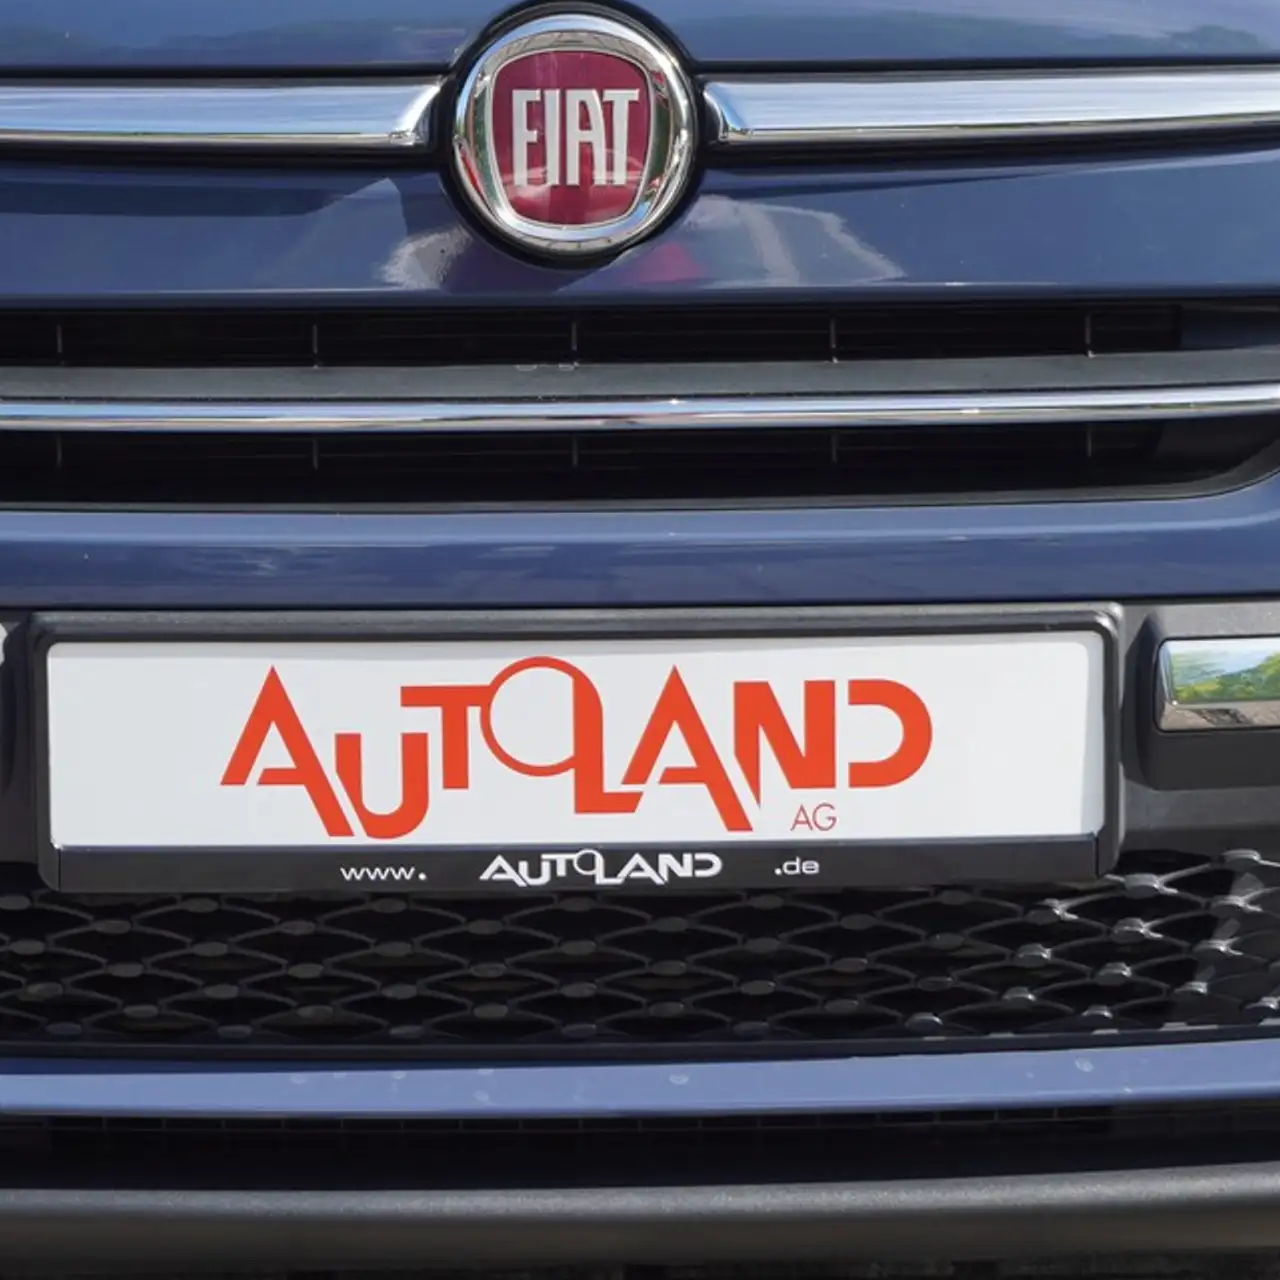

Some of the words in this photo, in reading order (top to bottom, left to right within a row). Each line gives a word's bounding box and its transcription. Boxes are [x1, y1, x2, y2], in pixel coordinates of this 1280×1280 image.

[511, 87, 640, 187] FIAT
[221, 656, 933, 840] AUTOLAND
[790, 802, 838, 832] AG
[339, 866, 427, 881] www.
[479, 848, 723, 887] AUTOLAND
[774, 856, 820, 876] .de
